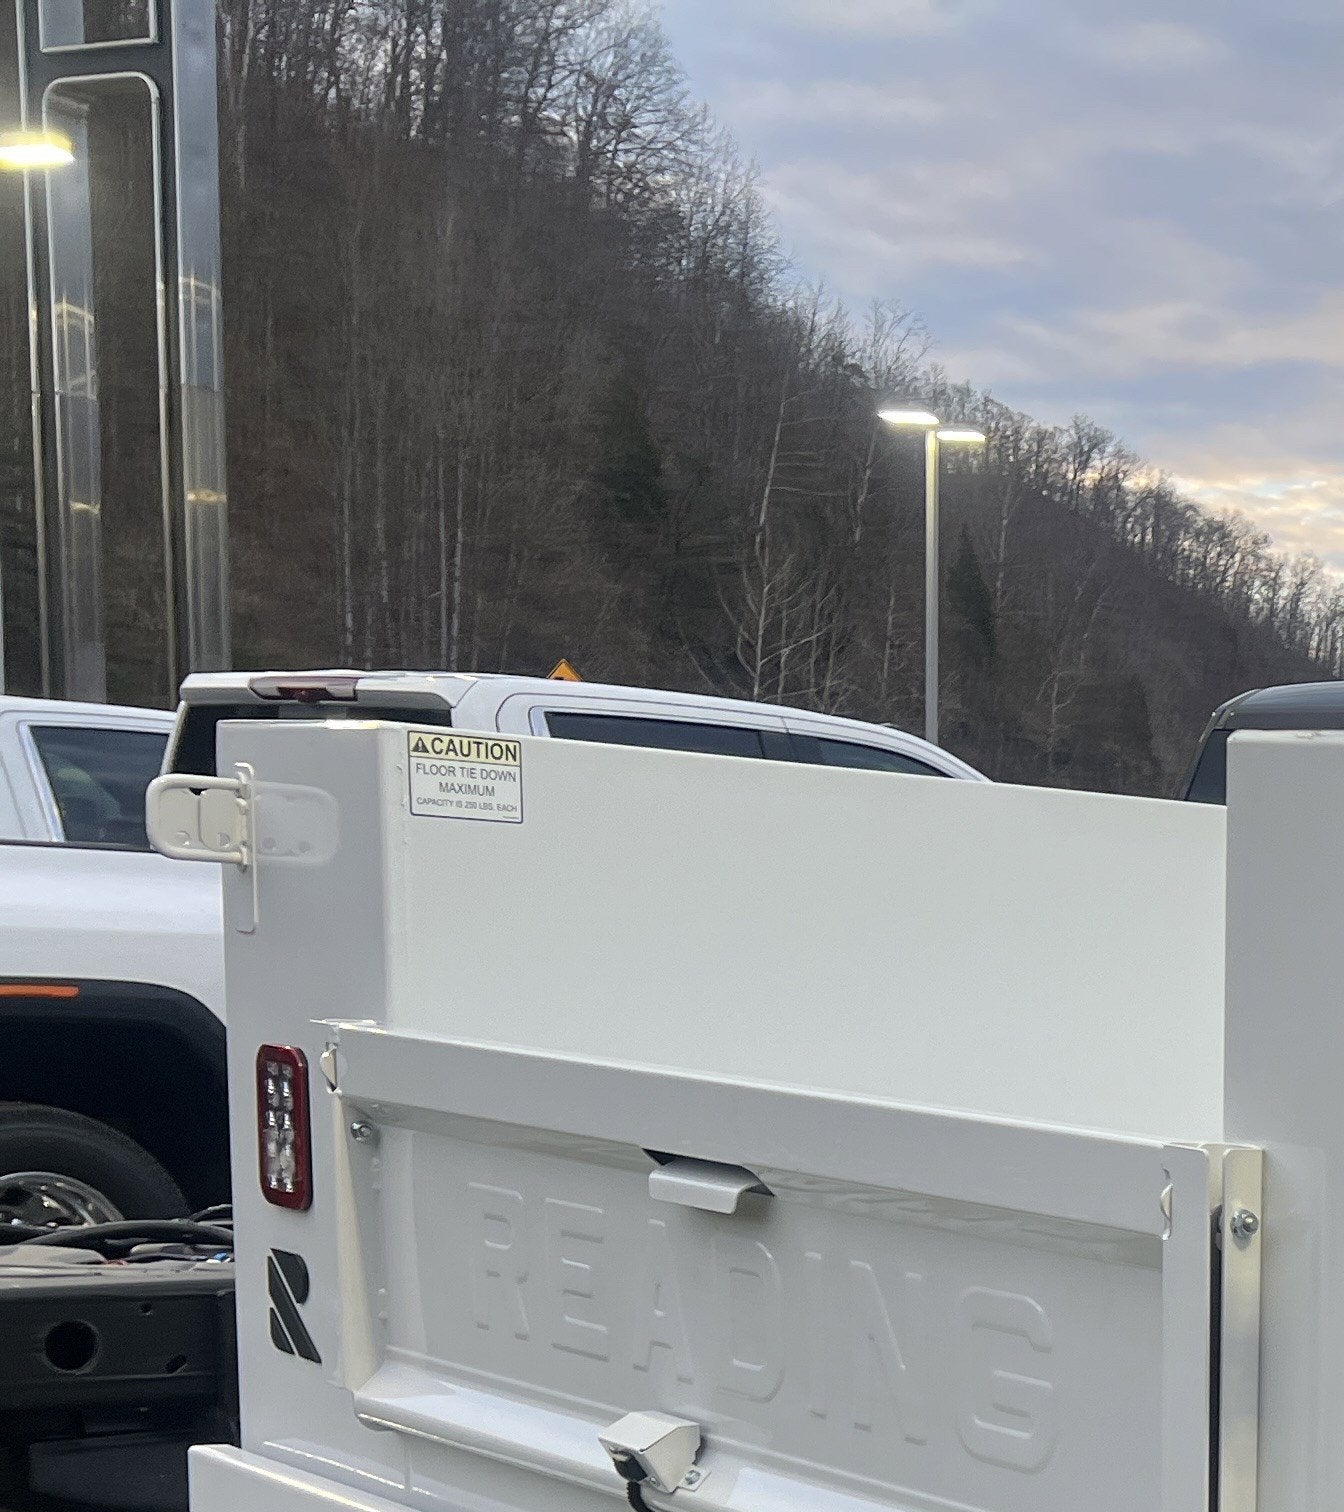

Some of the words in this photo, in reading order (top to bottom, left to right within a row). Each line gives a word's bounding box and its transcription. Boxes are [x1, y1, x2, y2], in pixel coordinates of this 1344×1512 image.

[431, 737, 517, 762] CAUTION
[415, 762, 456, 778] FLOOR
[459, 766, 478, 780] TIE
[480, 769, 517, 783] DOWN
[439, 781, 496, 797] MAXIMUM
[416, 796, 454, 807] CAPACITY
[496, 804, 518, 813] EACH
[466, 1181, 1056, 1473] READING
